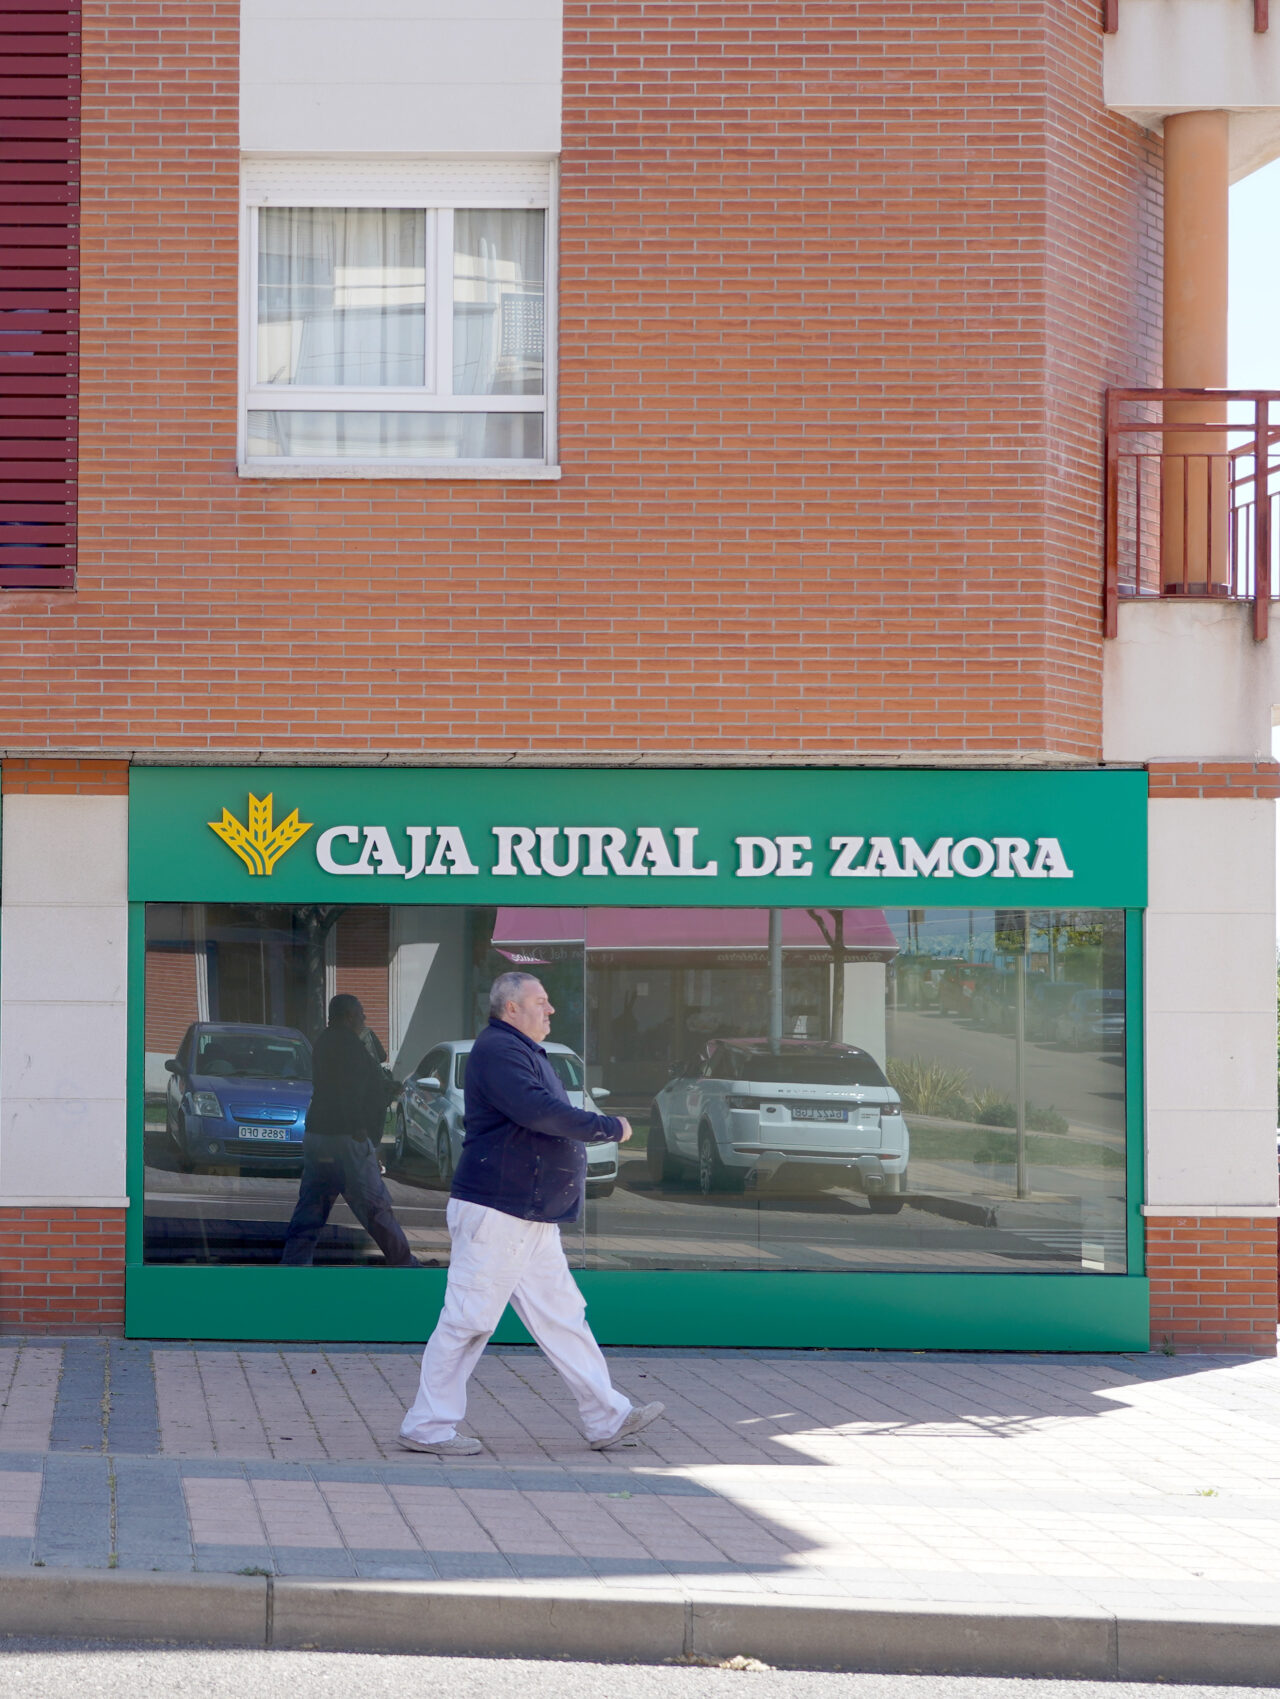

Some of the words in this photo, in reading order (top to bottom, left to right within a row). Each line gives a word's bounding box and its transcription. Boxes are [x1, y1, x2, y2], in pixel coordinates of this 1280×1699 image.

[315, 825, 480, 880] CAJA
[491, 826, 718, 877] RURAL
[735, 836, 813, 877] DE
[829, 836, 1074, 878] ZAMORA
